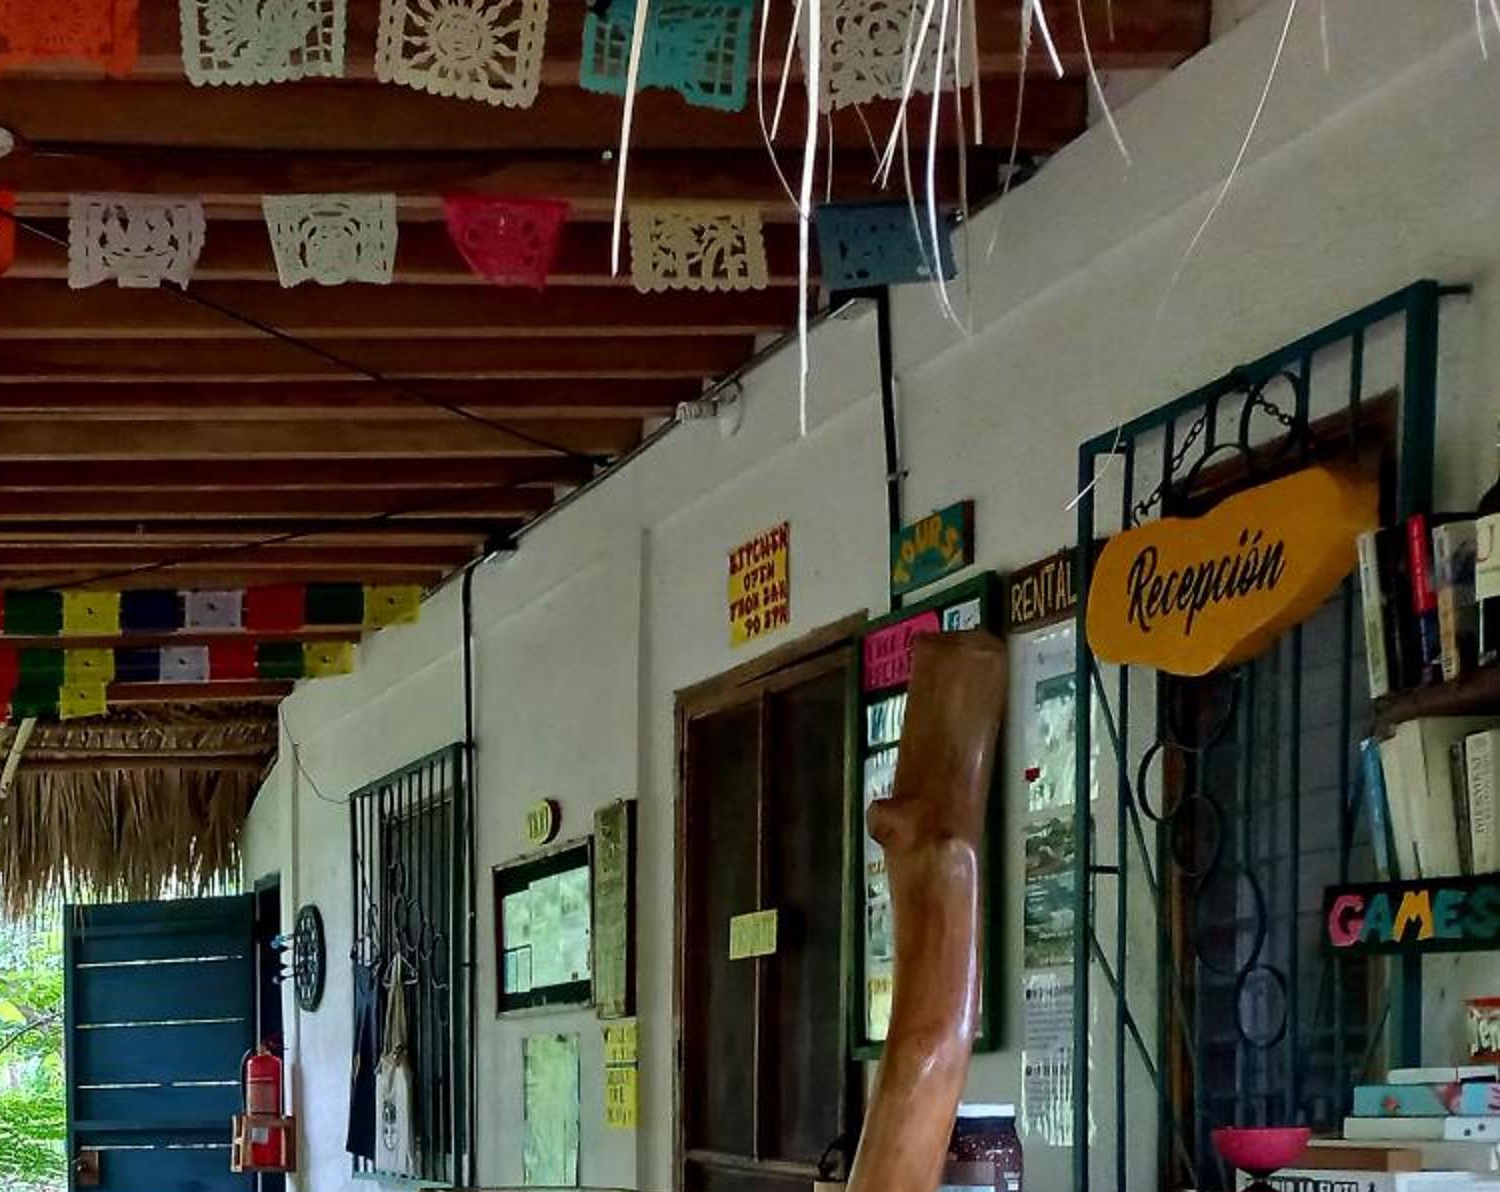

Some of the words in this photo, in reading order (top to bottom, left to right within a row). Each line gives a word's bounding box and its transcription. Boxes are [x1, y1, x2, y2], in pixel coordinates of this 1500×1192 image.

[743, 560, 775, 592] OPEN
[1127, 528, 1286, 636] Recepción
[1328, 883, 1500, 947] GAMES
